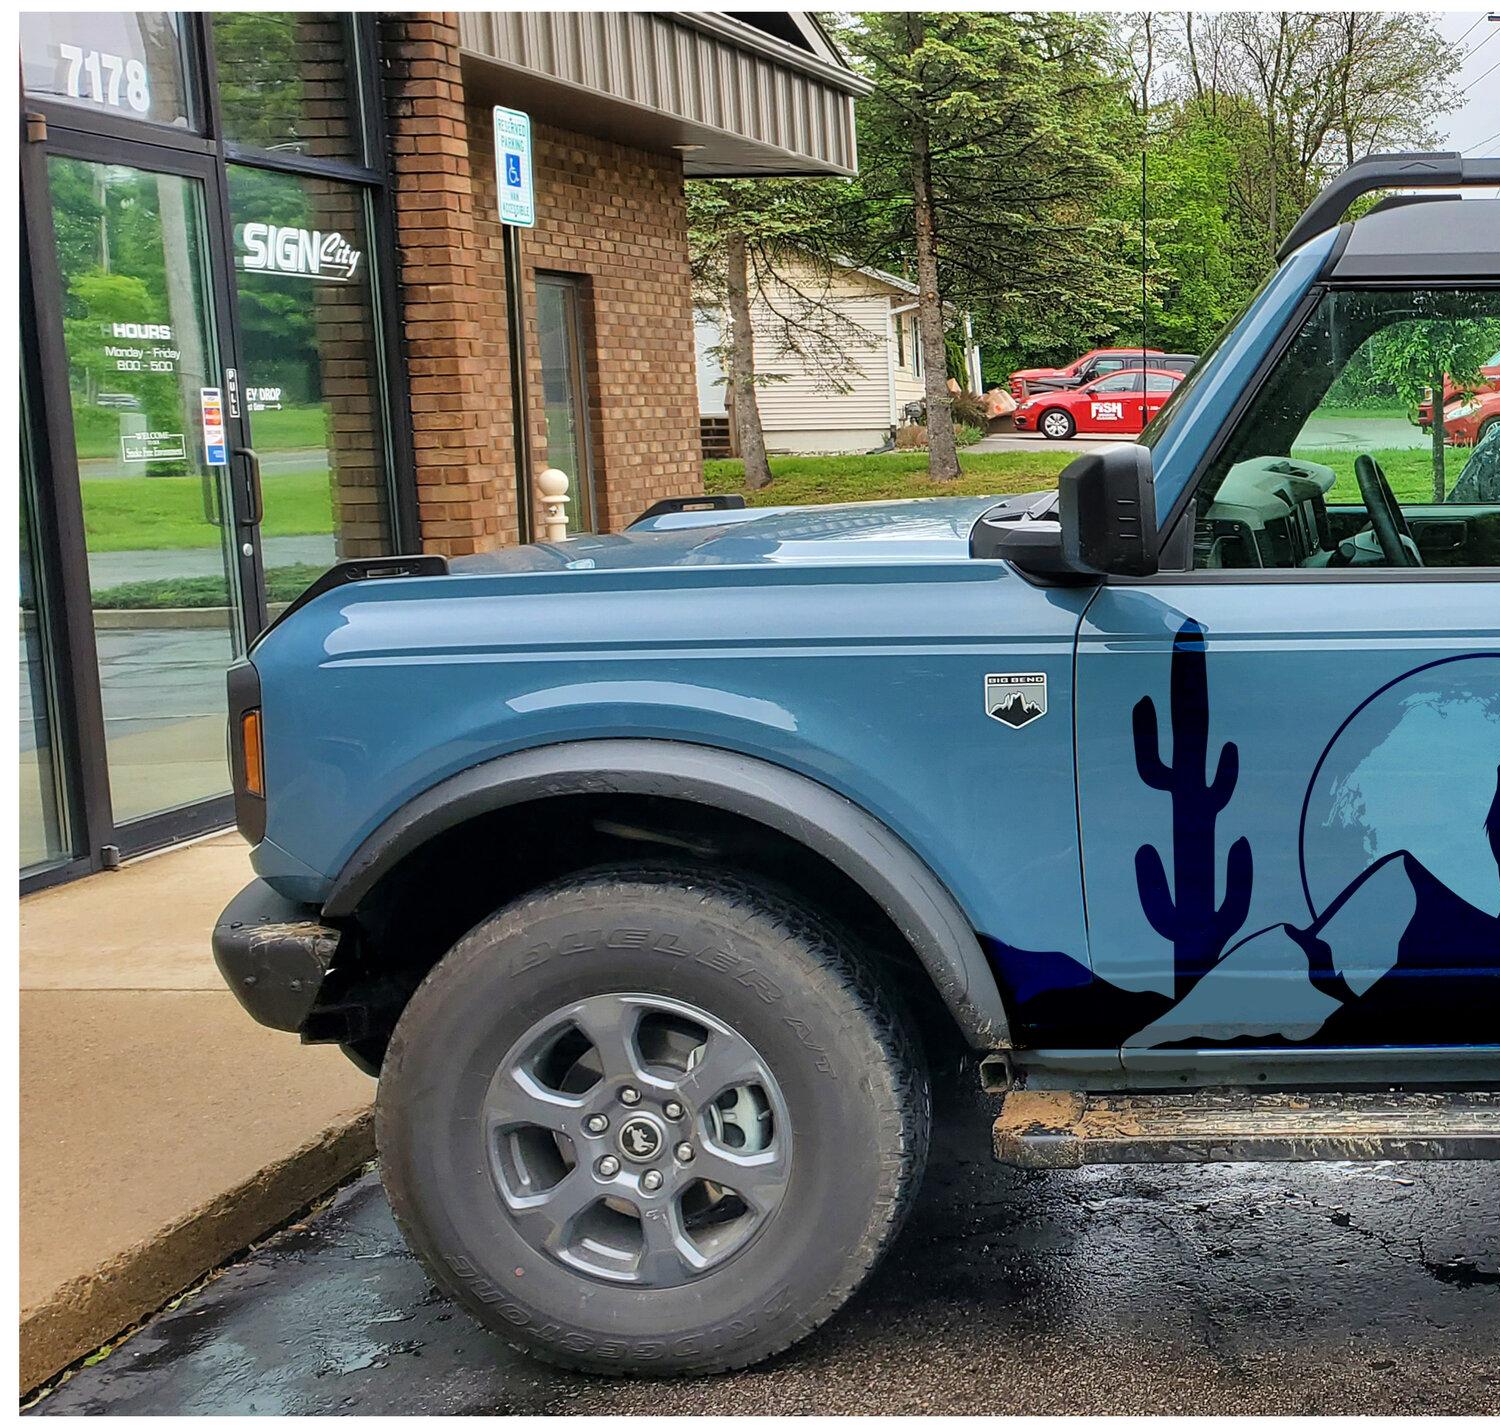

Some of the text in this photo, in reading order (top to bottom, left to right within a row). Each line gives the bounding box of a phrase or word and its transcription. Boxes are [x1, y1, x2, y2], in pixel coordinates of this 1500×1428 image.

[60, 43, 150, 112] 7178
[243, 222, 361, 277] SIGN City
[105, 346, 143, 359] Monday
[153, 347, 181, 360] Friday
[112, 323, 171, 339] HOURS
[228, 370, 238, 415] PULL
[246, 388, 281, 401] EY DROP
[510, 927, 785, 1004] DUELER
